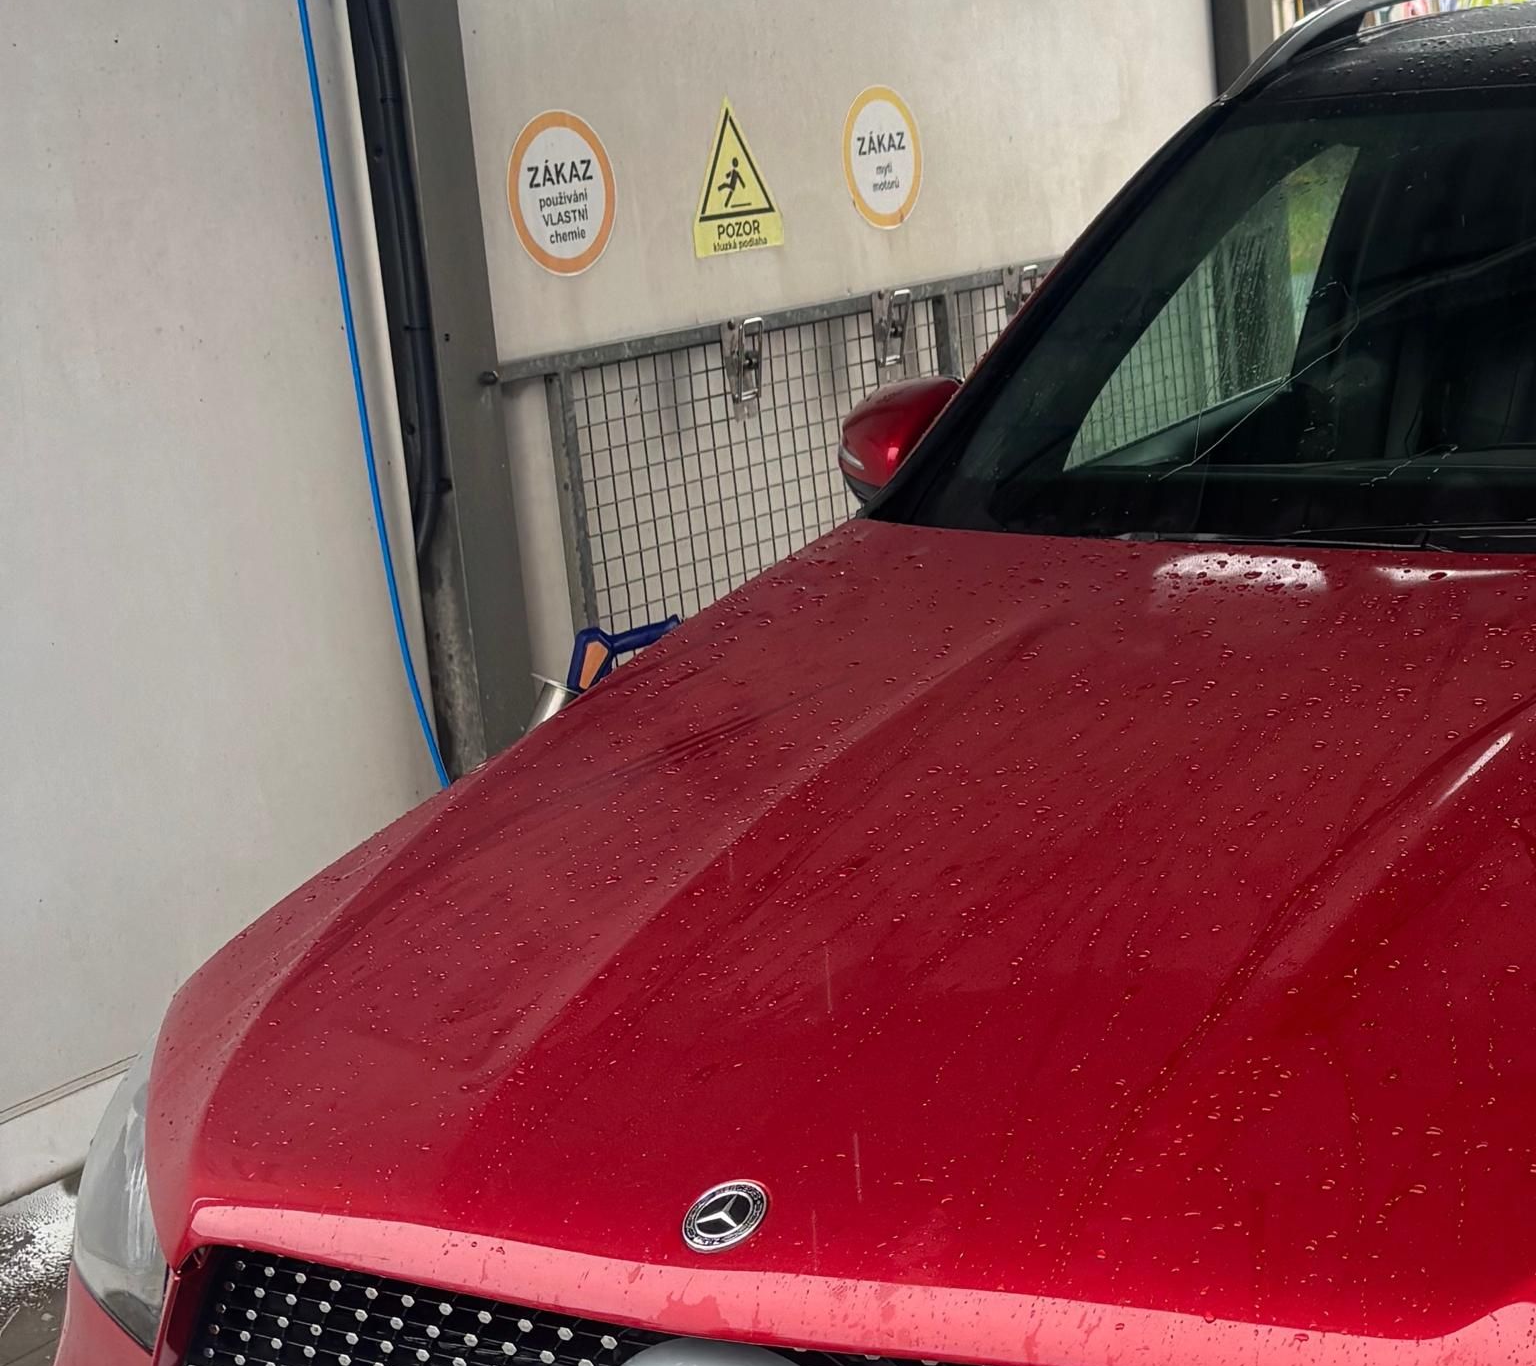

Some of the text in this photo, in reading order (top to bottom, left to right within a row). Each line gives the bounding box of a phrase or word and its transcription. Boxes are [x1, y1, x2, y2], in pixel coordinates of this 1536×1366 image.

[857, 131, 905, 156] ZÁKAZ
[527, 159, 593, 188] ZÁKAZ
[539, 187, 588, 211] používání
[542, 204, 588, 227] VLASTNÍ
[550, 226, 586, 244] chemie
[717, 219, 760, 240] POZOR
